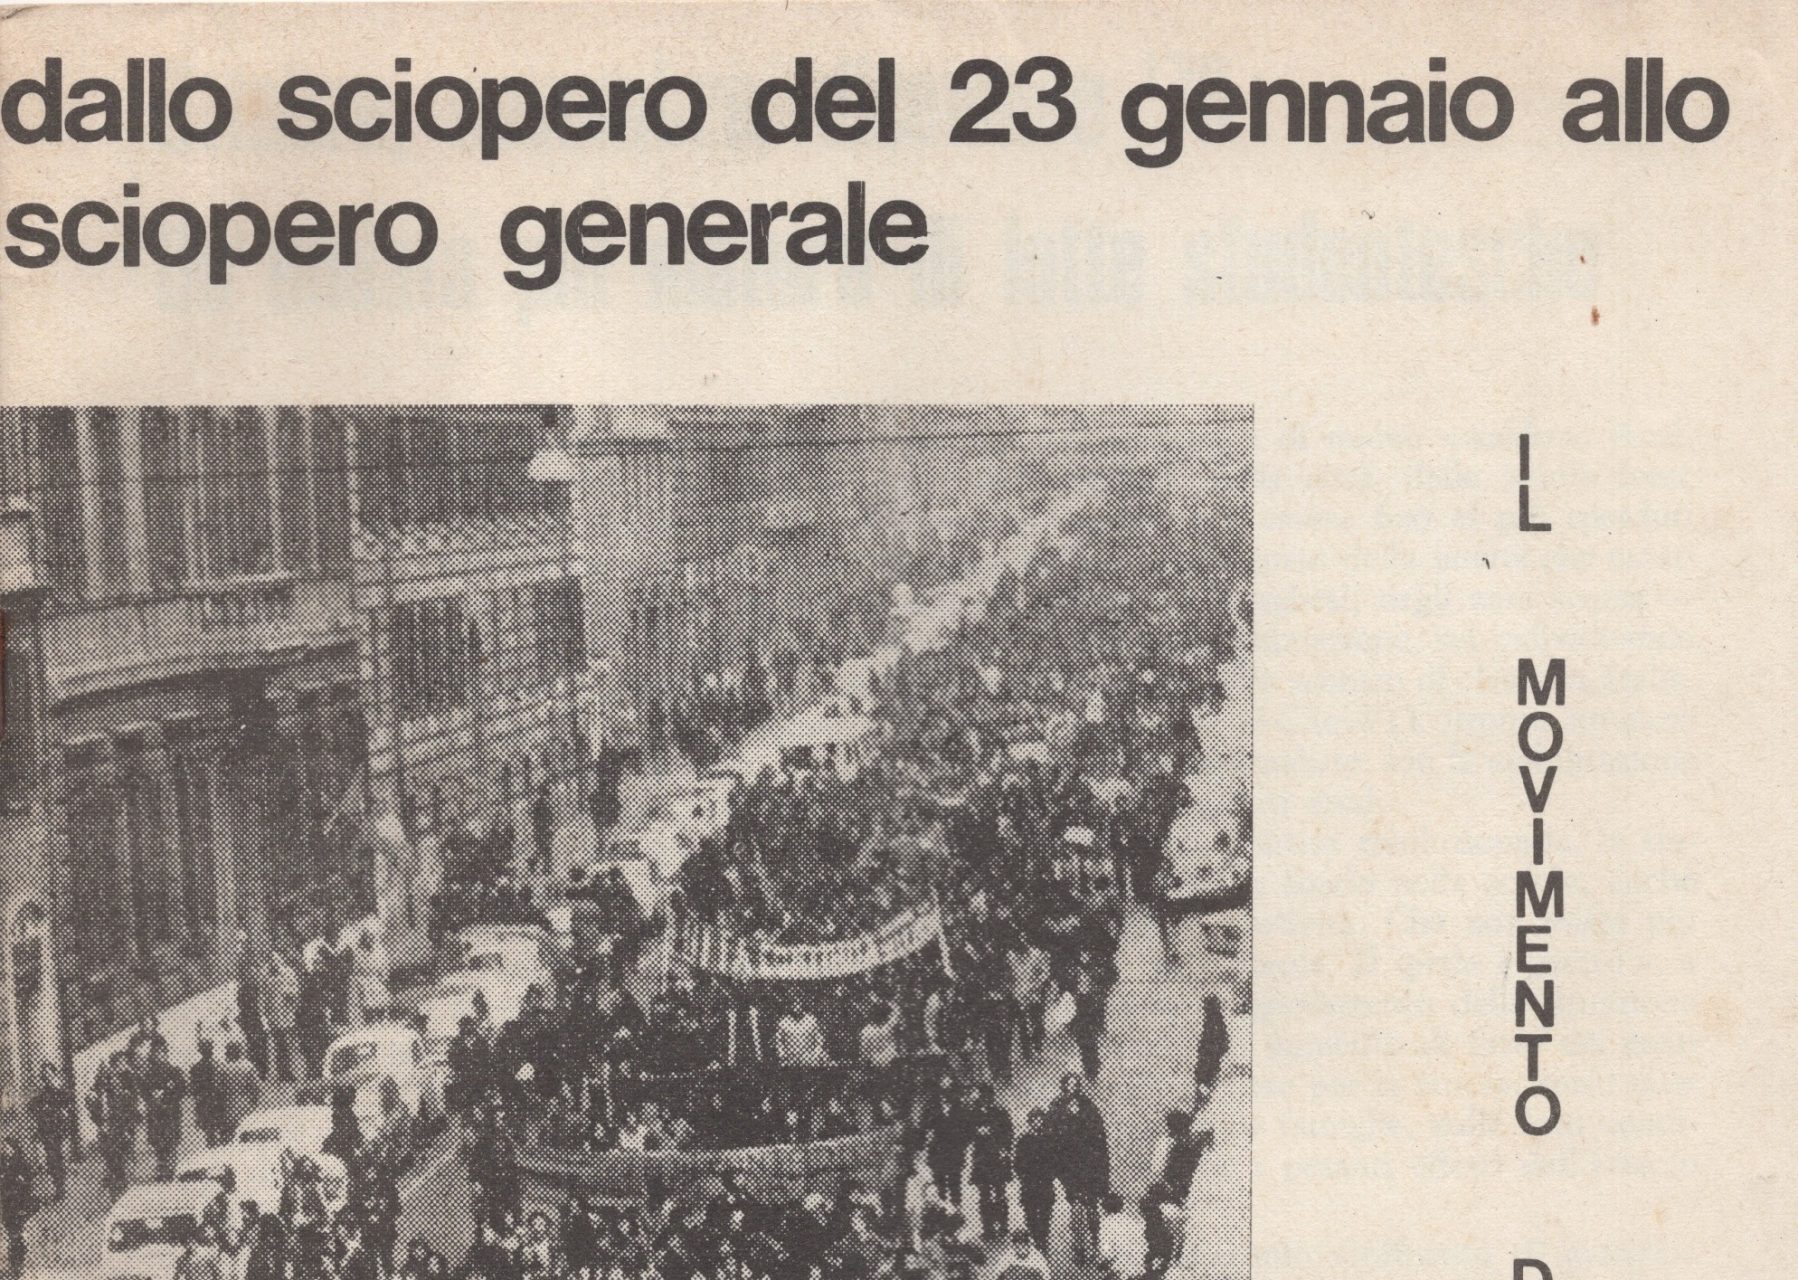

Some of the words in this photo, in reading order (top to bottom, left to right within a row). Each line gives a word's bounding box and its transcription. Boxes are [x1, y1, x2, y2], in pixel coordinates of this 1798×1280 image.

[1, 57, 232, 144] dallo
[278, 58, 707, 160] sciopero
[751, 57, 895, 144] del
[950, 56, 1076, 143] 23
[1121, 57, 1514, 168] gennaio
[1563, 57, 1729, 143] allo
[5, 183, 438, 285] sciopero
[500, 181, 929, 290] generale
[1519, 433, 1552, 532] IL
[1514, 658, 1566, 1136] MOVIMENTO
